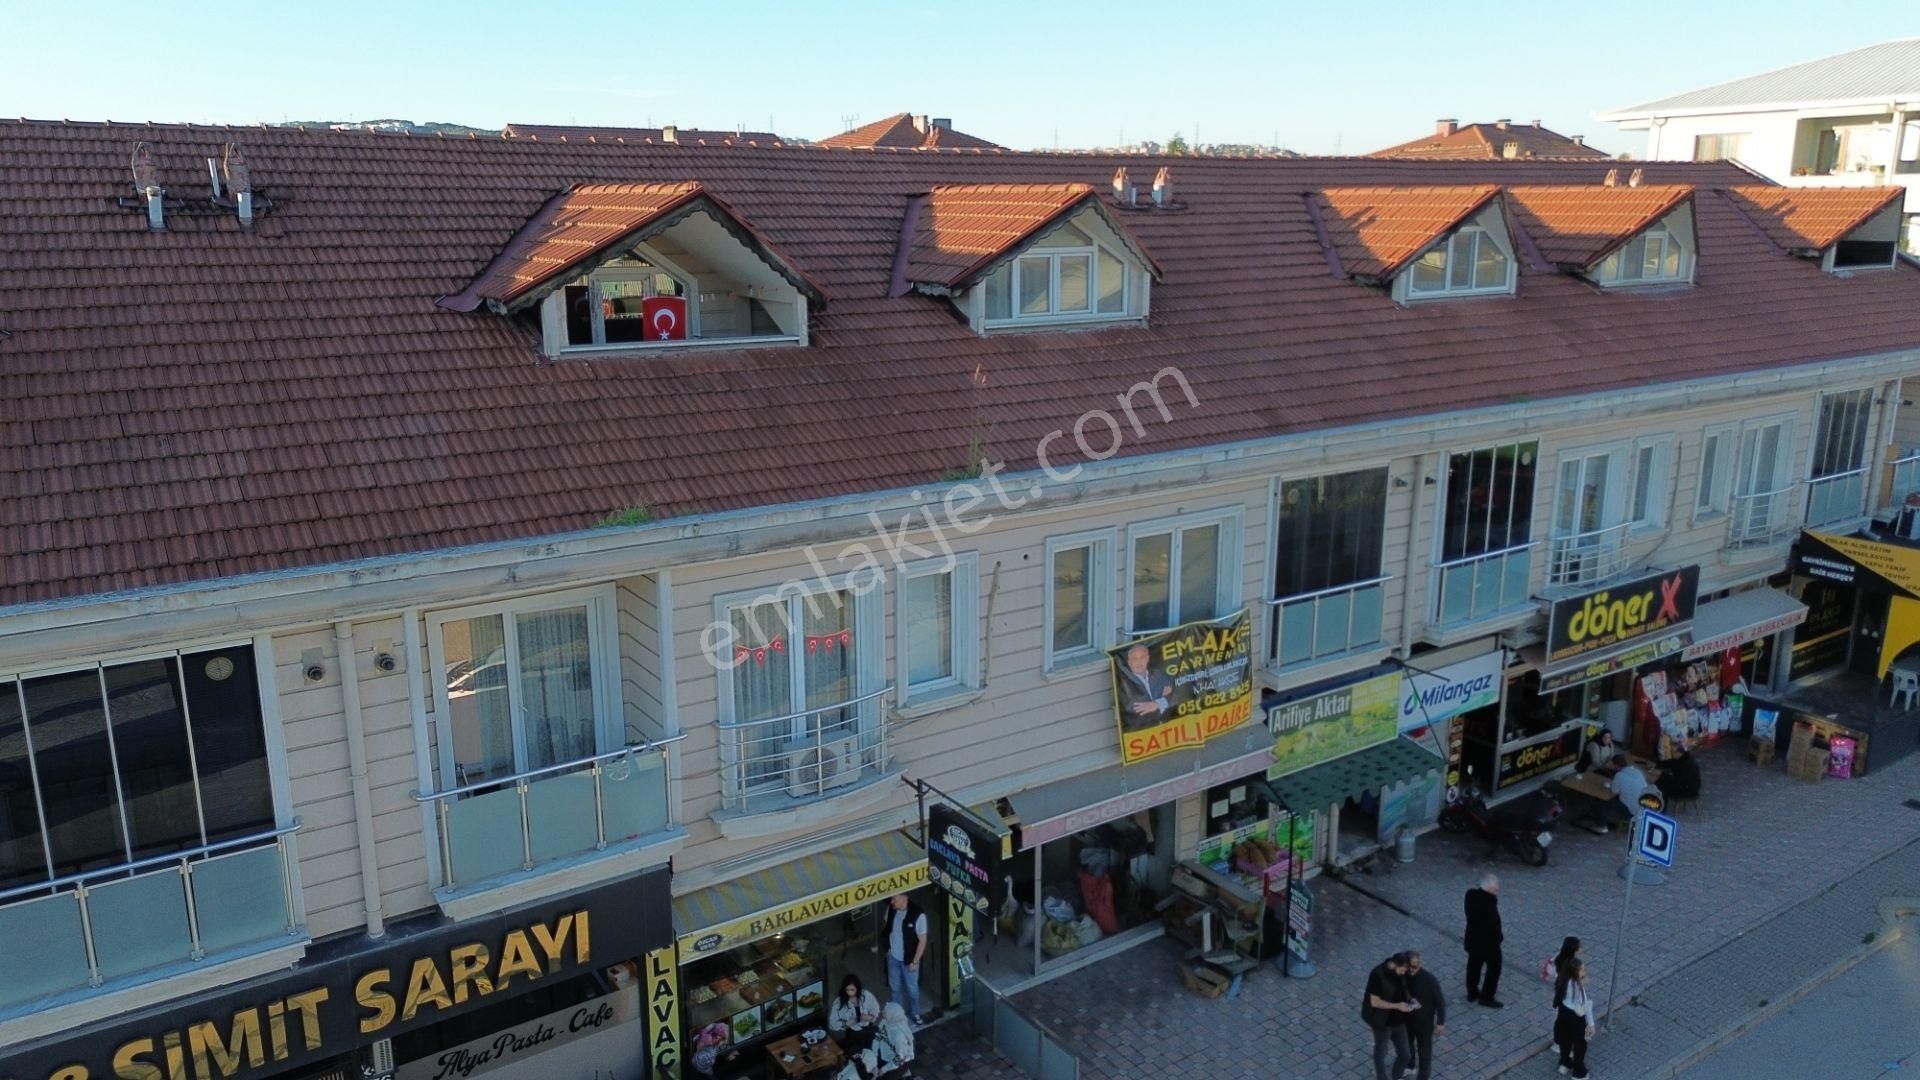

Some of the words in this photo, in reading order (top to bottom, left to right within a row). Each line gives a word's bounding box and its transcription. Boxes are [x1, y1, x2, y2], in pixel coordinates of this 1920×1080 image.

[1568, 591, 1654, 642] döner
[1656, 570, 1683, 622] X
[1421, 673, 1493, 709] Milangaz
[1273, 703, 1311, 733] Arifiye
[1314, 694, 1351, 720] Aktar
[1516, 743, 1553, 768] döner
[1645, 820, 1669, 852] D
[930, 838, 961, 866] BAKLAVA
[965, 860, 989, 883] PASTA
[946, 860, 972, 885] YUFKA
[750, 893, 851, 936] BAKLAVACI
[854, 873, 911, 901] ÖZCAN
[355, 910, 590, 1033] SARAYI
[434, 1050, 492, 1079] Alya
[493, 1023, 556, 1058] Pasta
[569, 1002, 615, 1034] Cafe
